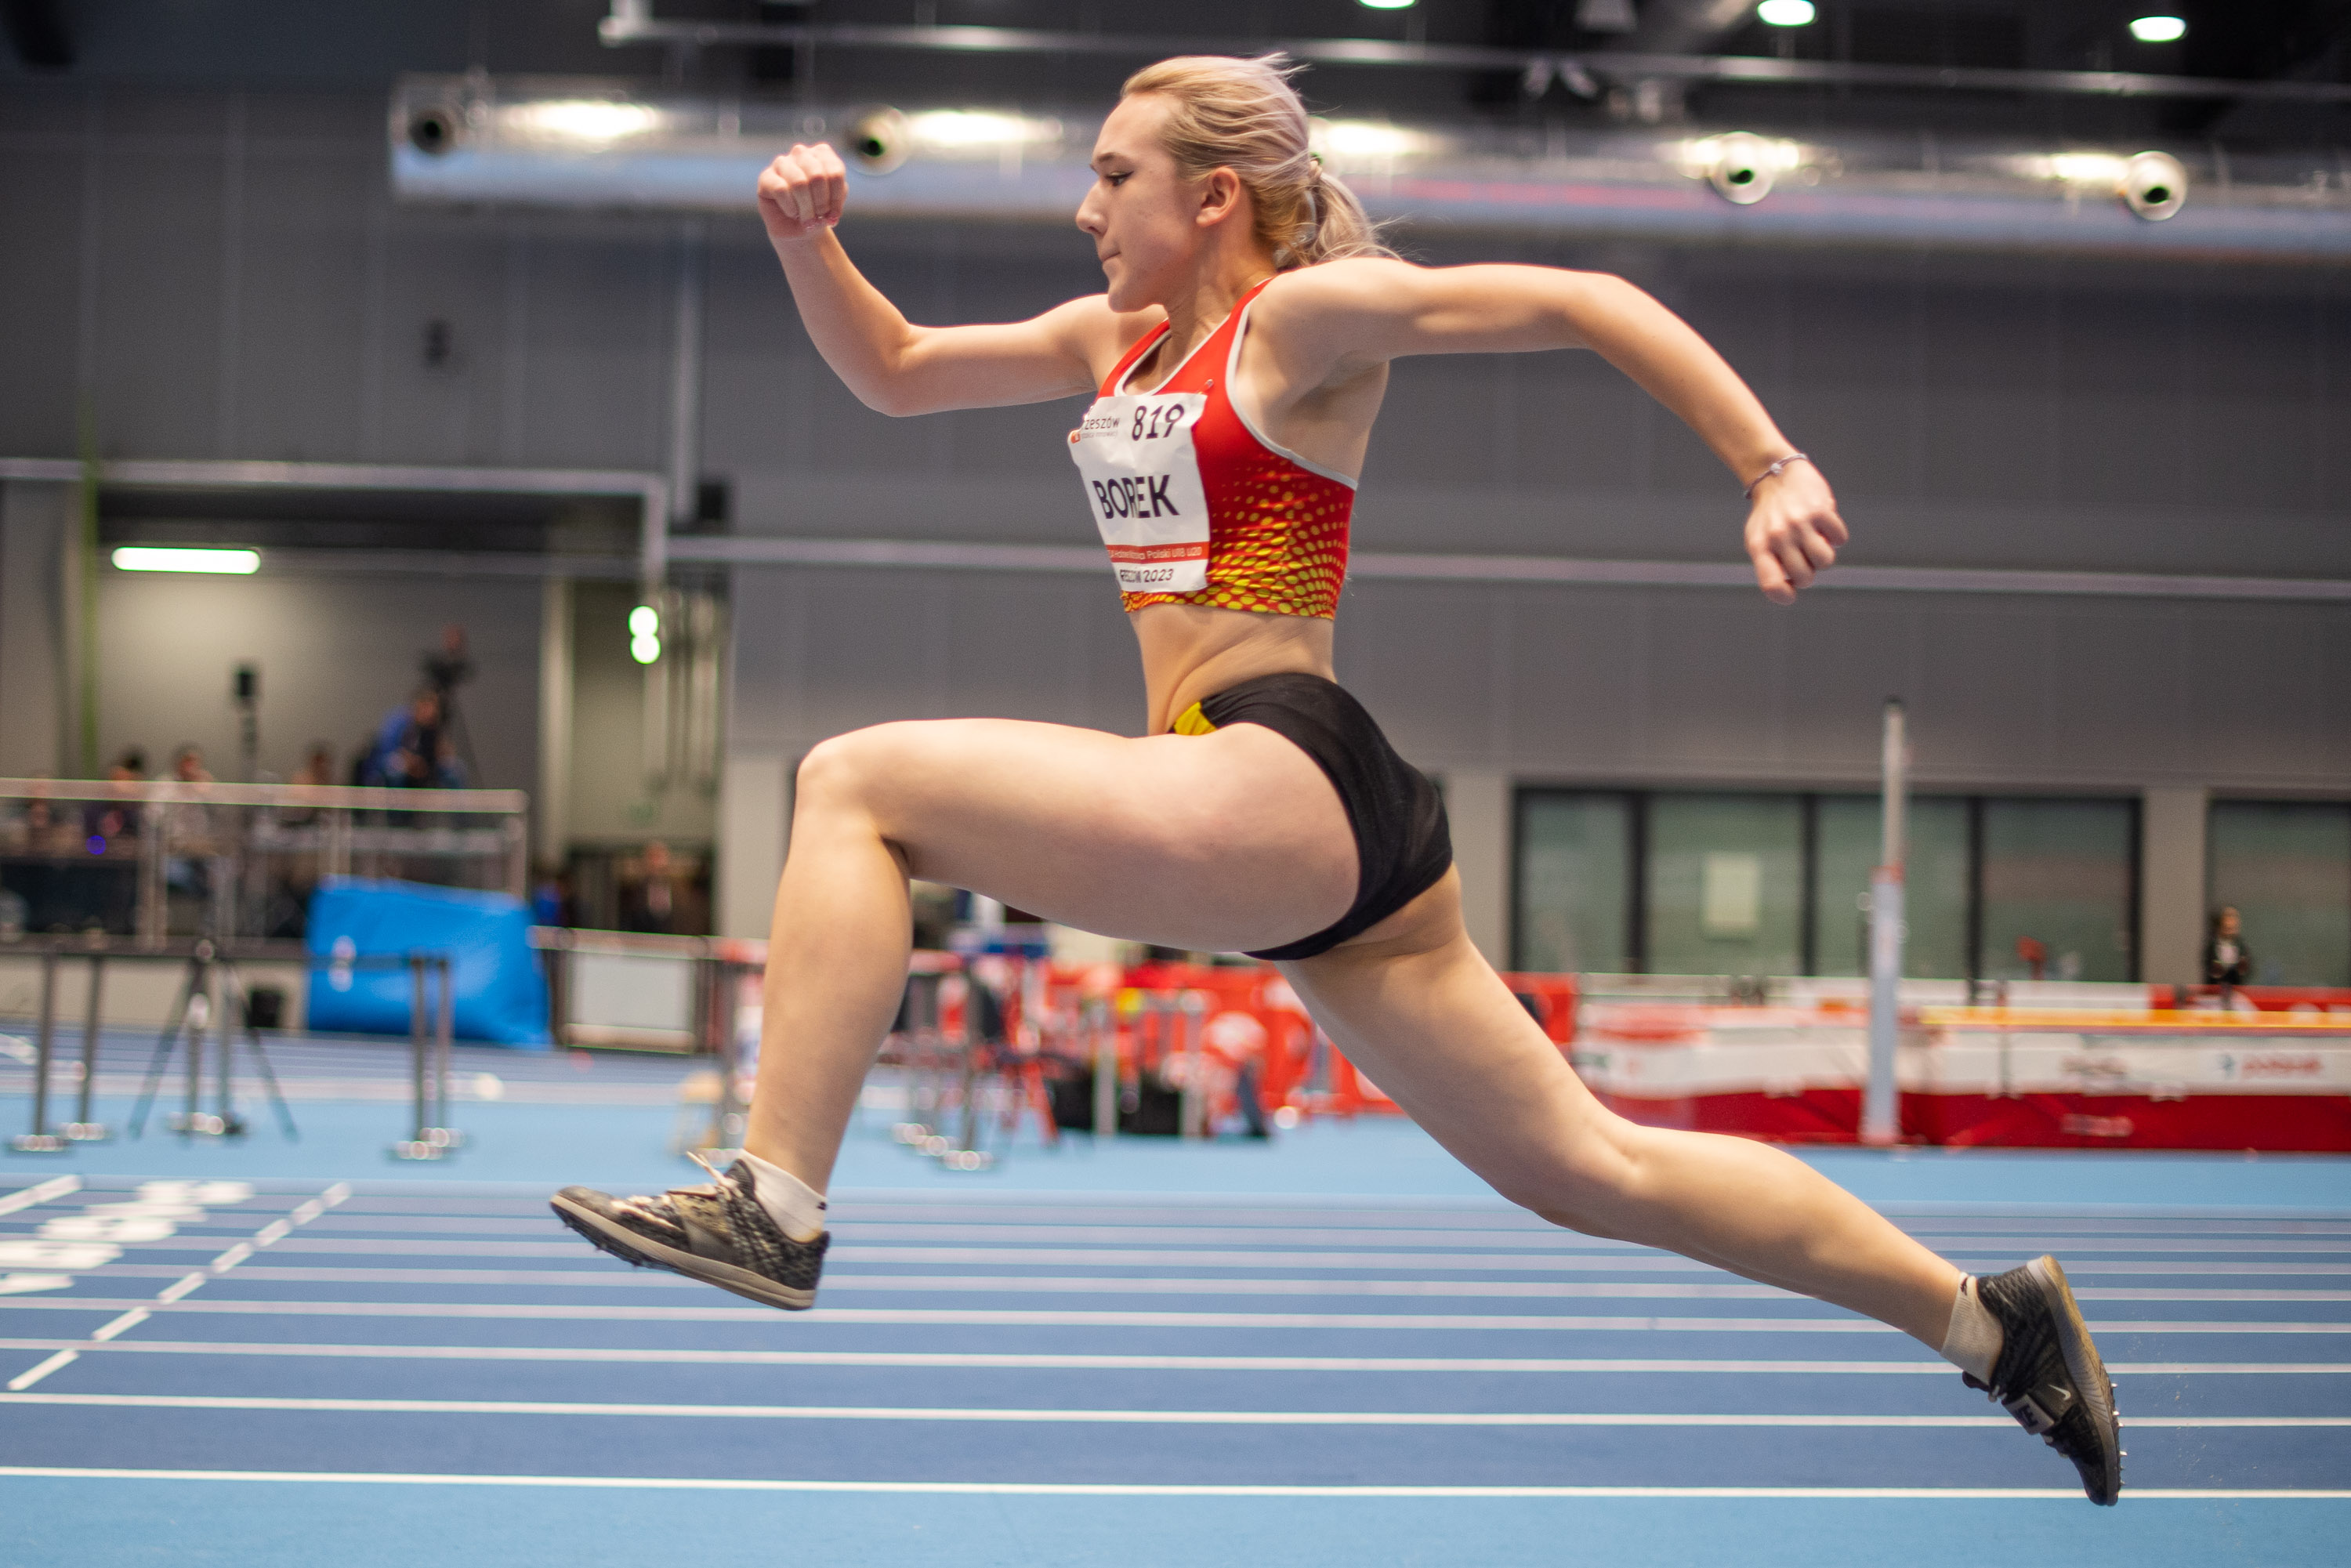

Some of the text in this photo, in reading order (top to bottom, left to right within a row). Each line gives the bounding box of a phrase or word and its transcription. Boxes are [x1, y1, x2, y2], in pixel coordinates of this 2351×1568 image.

[1082, 416, 1121, 430] zeszów
[1132, 403, 1185, 441] 819
[1092, 474, 1180, 520] BOREK
[1143, 568, 1174, 582] 2023
